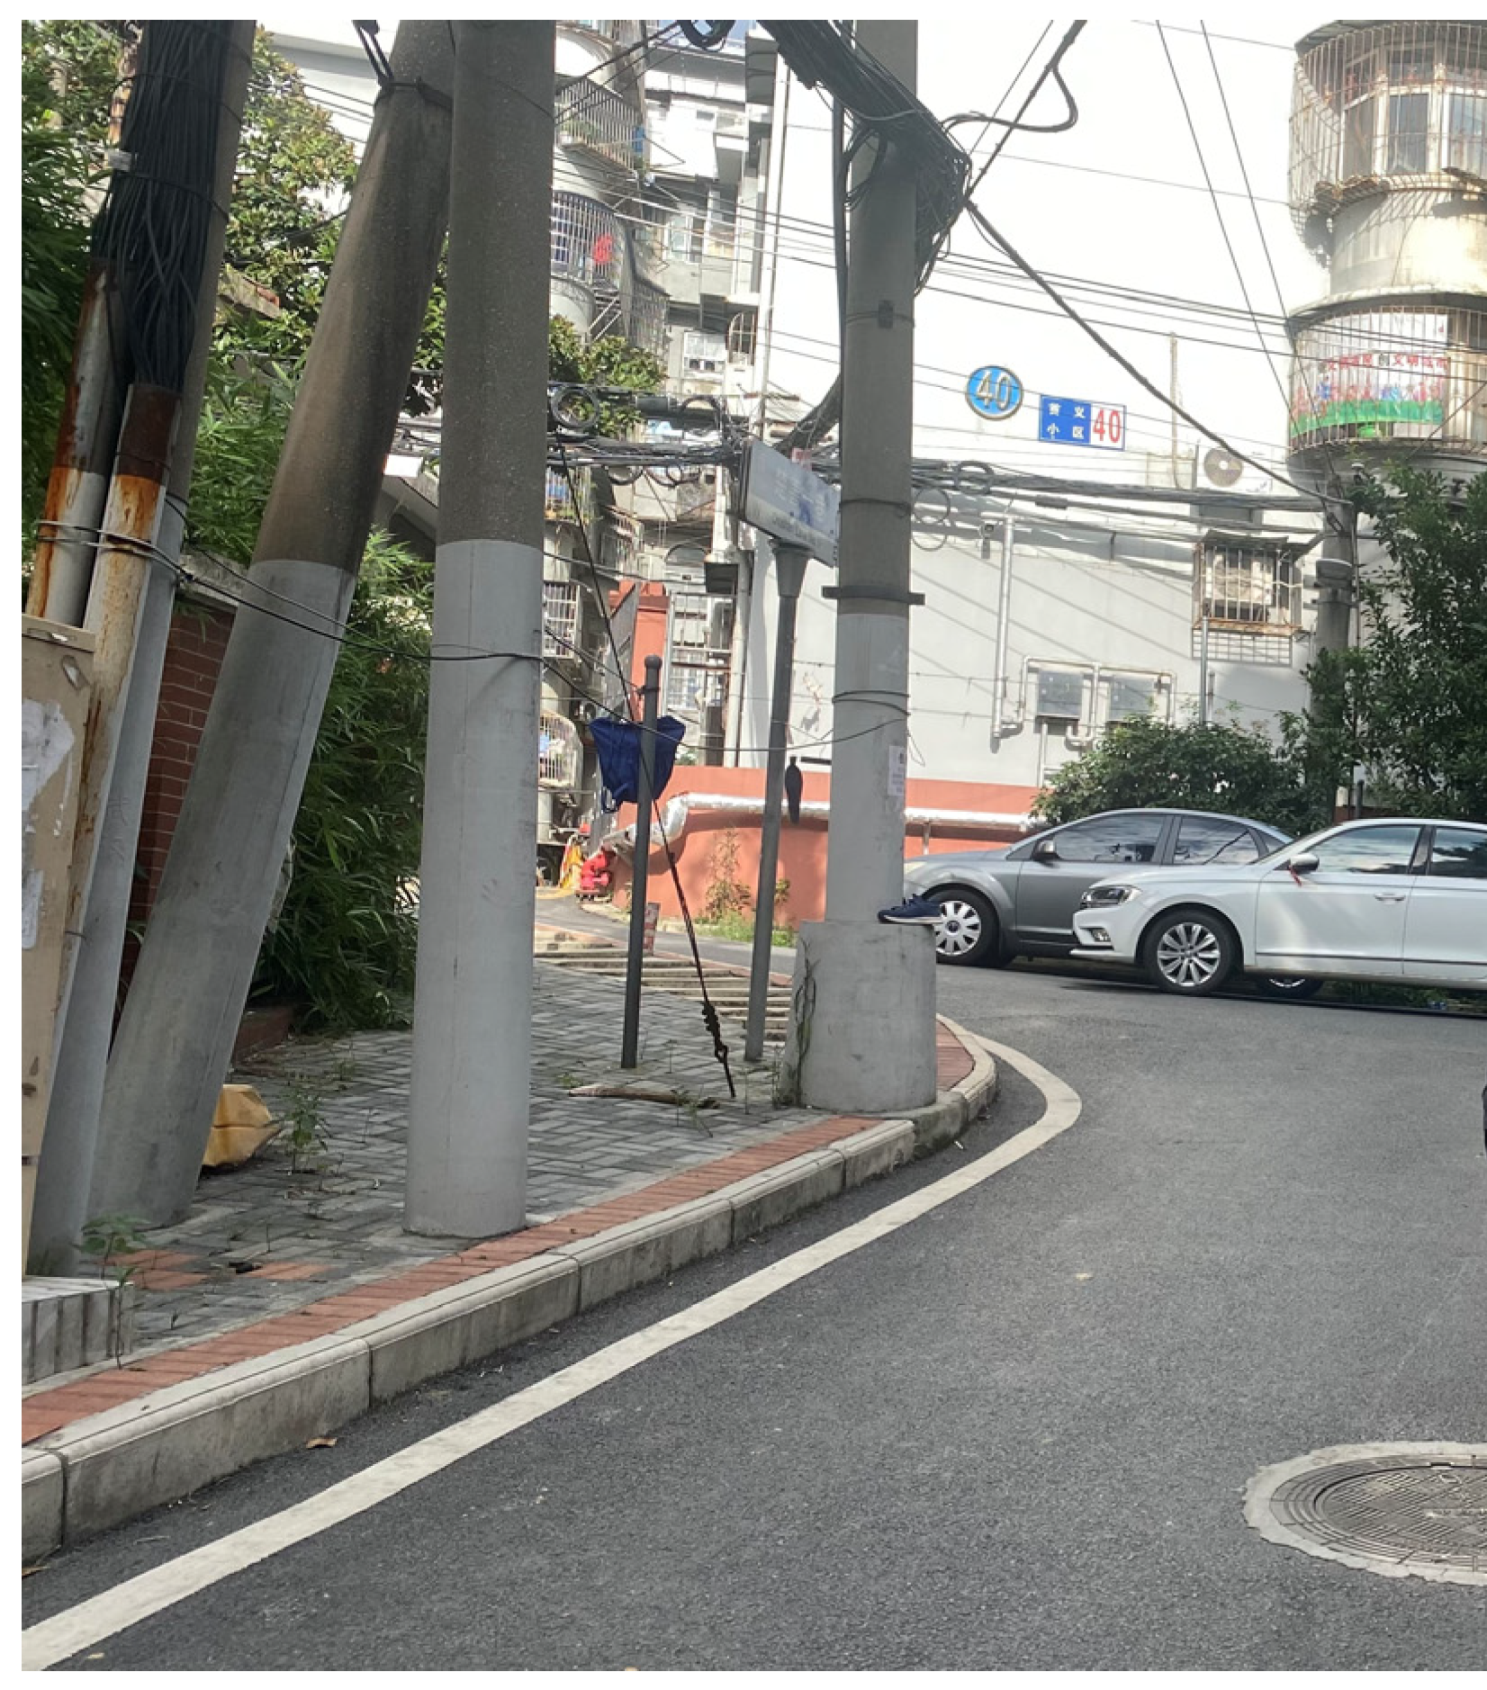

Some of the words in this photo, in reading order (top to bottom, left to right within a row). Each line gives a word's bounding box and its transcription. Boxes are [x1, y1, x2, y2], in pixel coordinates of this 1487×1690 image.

[976, 370, 1011, 411] 40
[1047, 423, 1085, 440] 小区
[1093, 408, 1121, 443] 40
